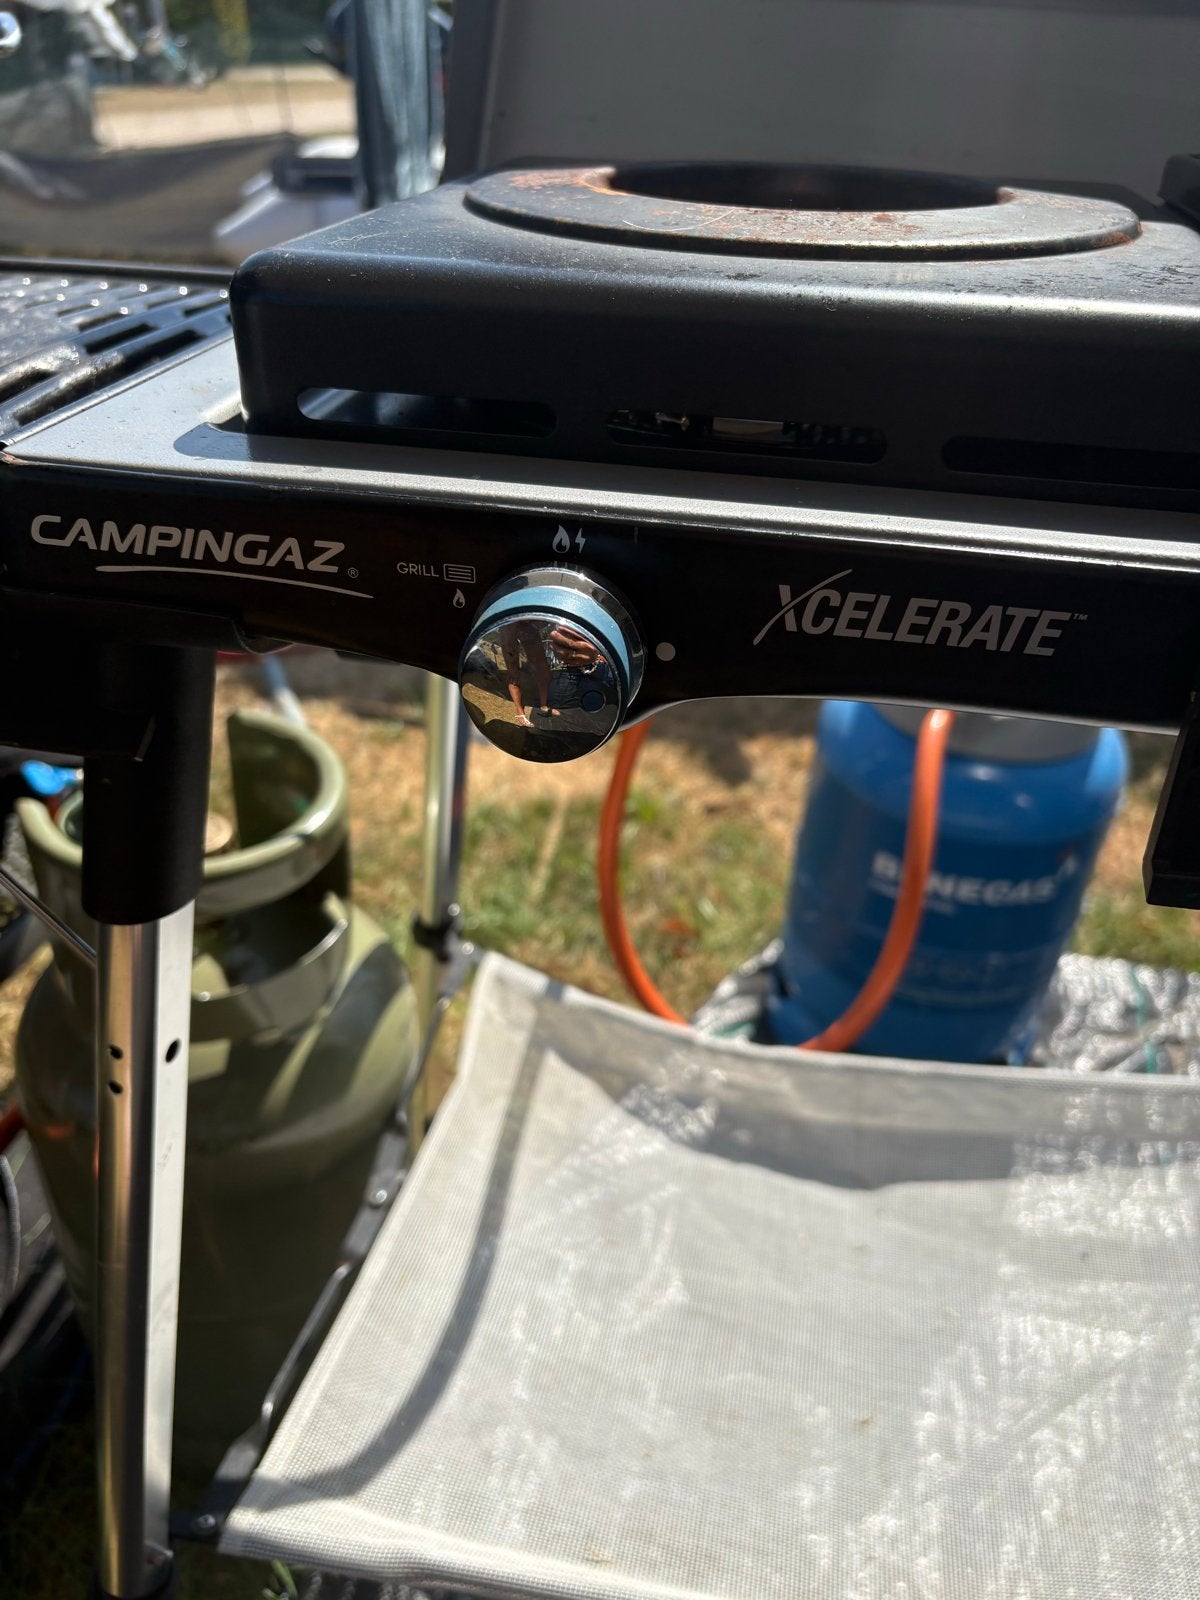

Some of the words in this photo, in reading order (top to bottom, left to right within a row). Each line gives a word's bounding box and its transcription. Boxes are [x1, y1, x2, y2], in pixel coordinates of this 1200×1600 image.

[30, 514, 346, 574] CAMPINGAZ
[396, 561, 440, 578] GRILL
[871, 852, 1055, 906] BNEGAS
